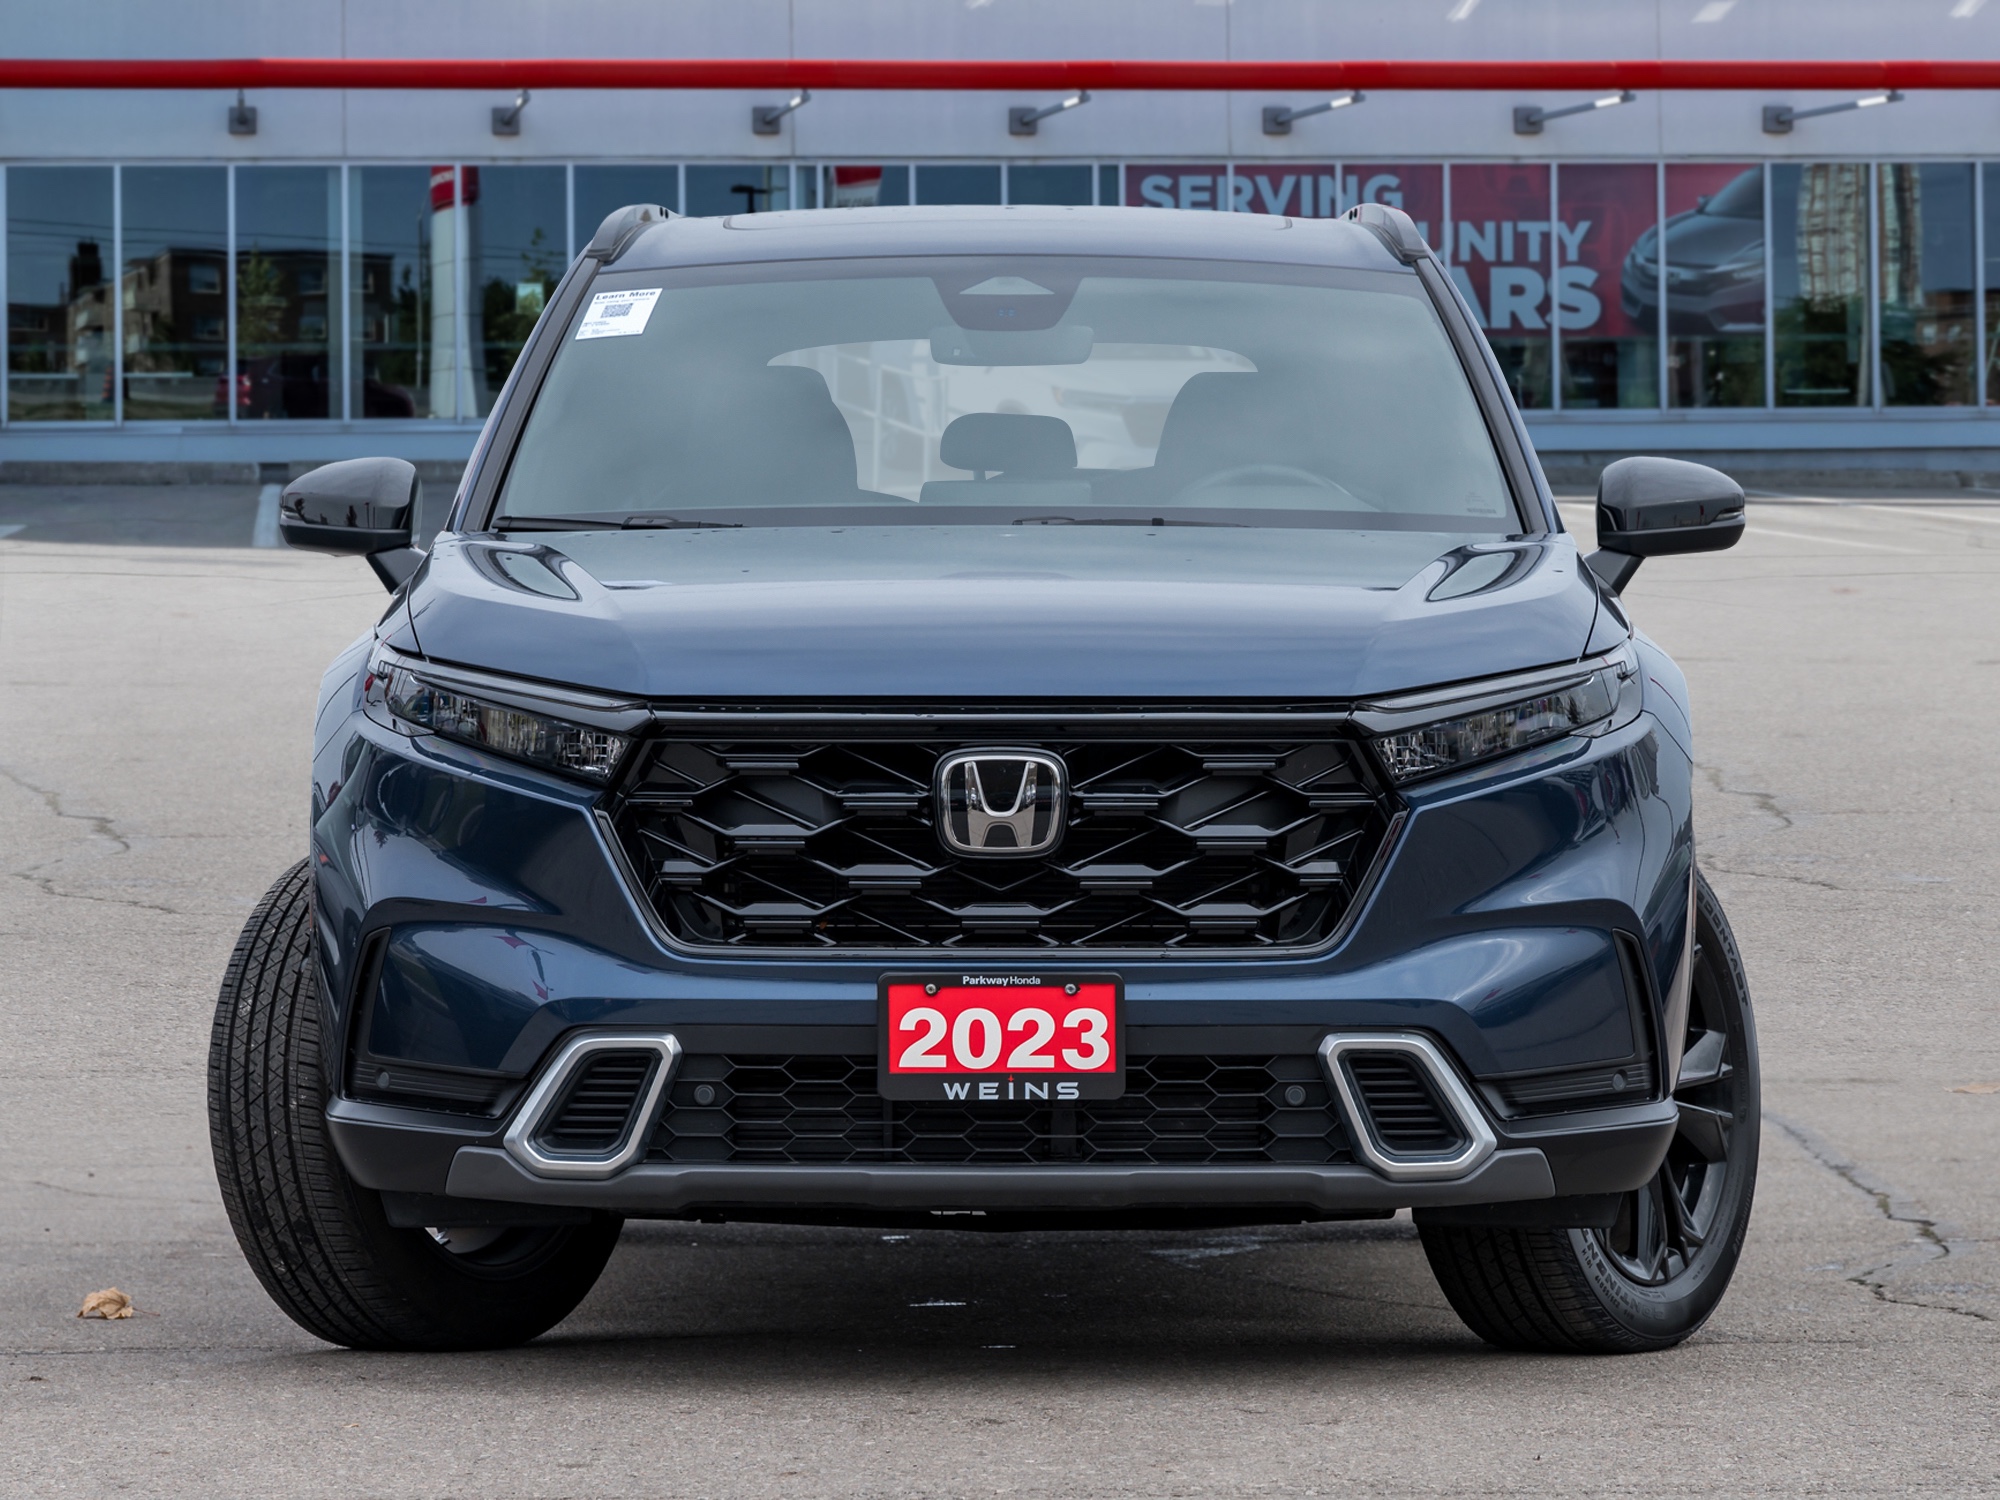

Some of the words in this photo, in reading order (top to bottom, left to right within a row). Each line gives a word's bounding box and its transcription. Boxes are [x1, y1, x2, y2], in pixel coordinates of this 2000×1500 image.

[1140, 174, 1404, 218] SERVING
[962, 975, 1009, 987] Parkway
[1009, 975, 1041, 985] Honda
[898, 1007, 1110, 1070] 2023
[943, 1078, 1080, 1100] WEINS
